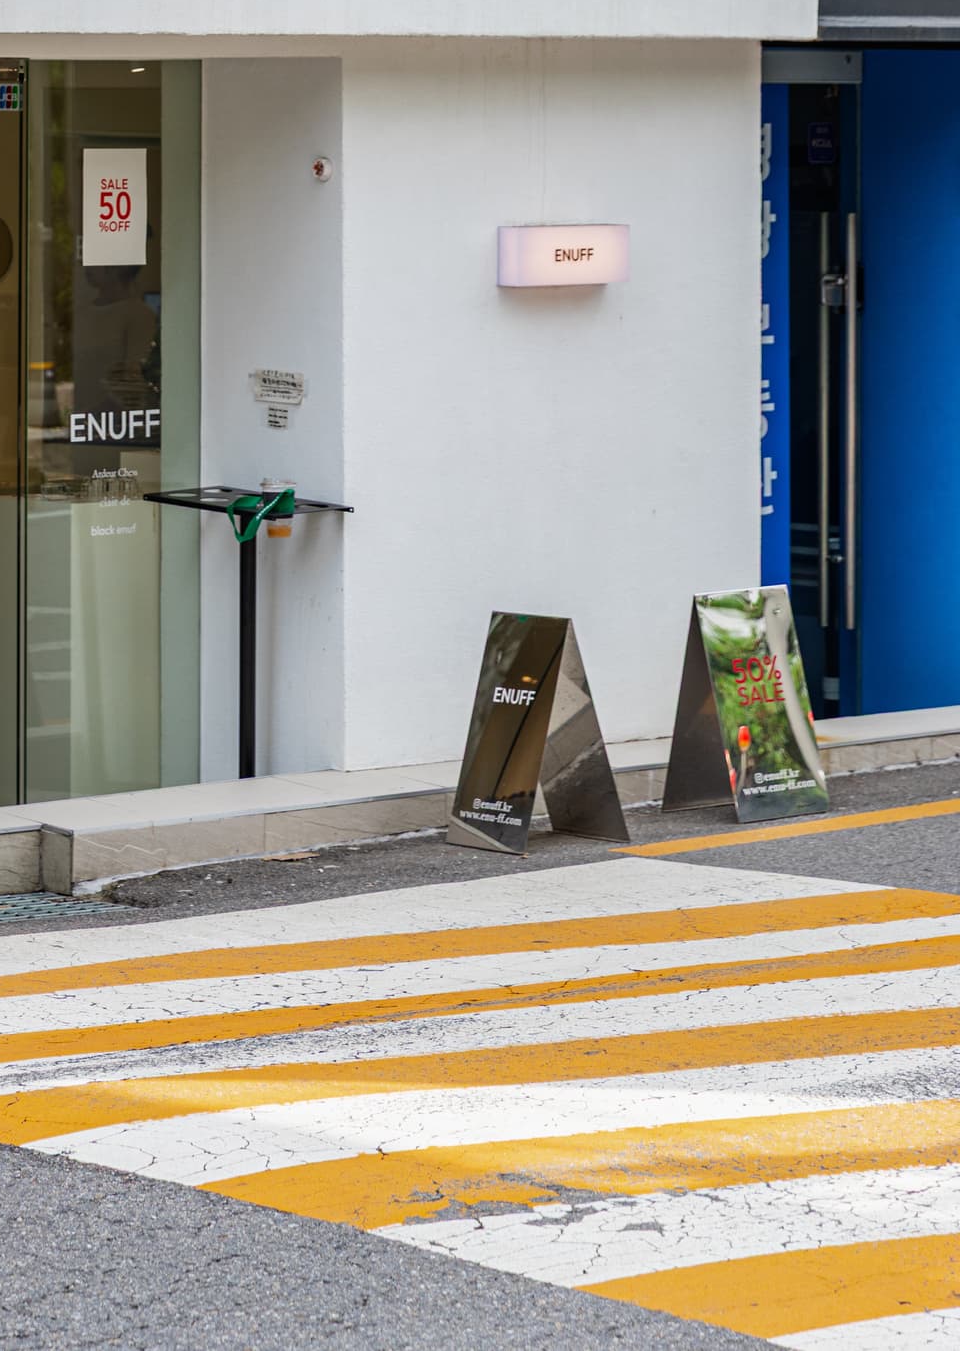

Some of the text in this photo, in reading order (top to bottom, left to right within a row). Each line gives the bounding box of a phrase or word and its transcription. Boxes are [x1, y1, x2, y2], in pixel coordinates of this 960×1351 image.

[100, 178, 129, 190] SALE
[99, 191, 131, 220] 50
[98, 221, 131, 232] %OFF
[555, 248, 594, 262] ENUFF
[70, 409, 161, 442] ENUFF
[732, 655, 782, 684] 50%
[492, 686, 536, 706] ENUFF
[737, 682, 786, 707] SALE
[753, 768, 801, 784] @enuff.kr
[472, 797, 514, 812] @enuff.kr
[459, 809, 523, 826] www.enu-ff.com
